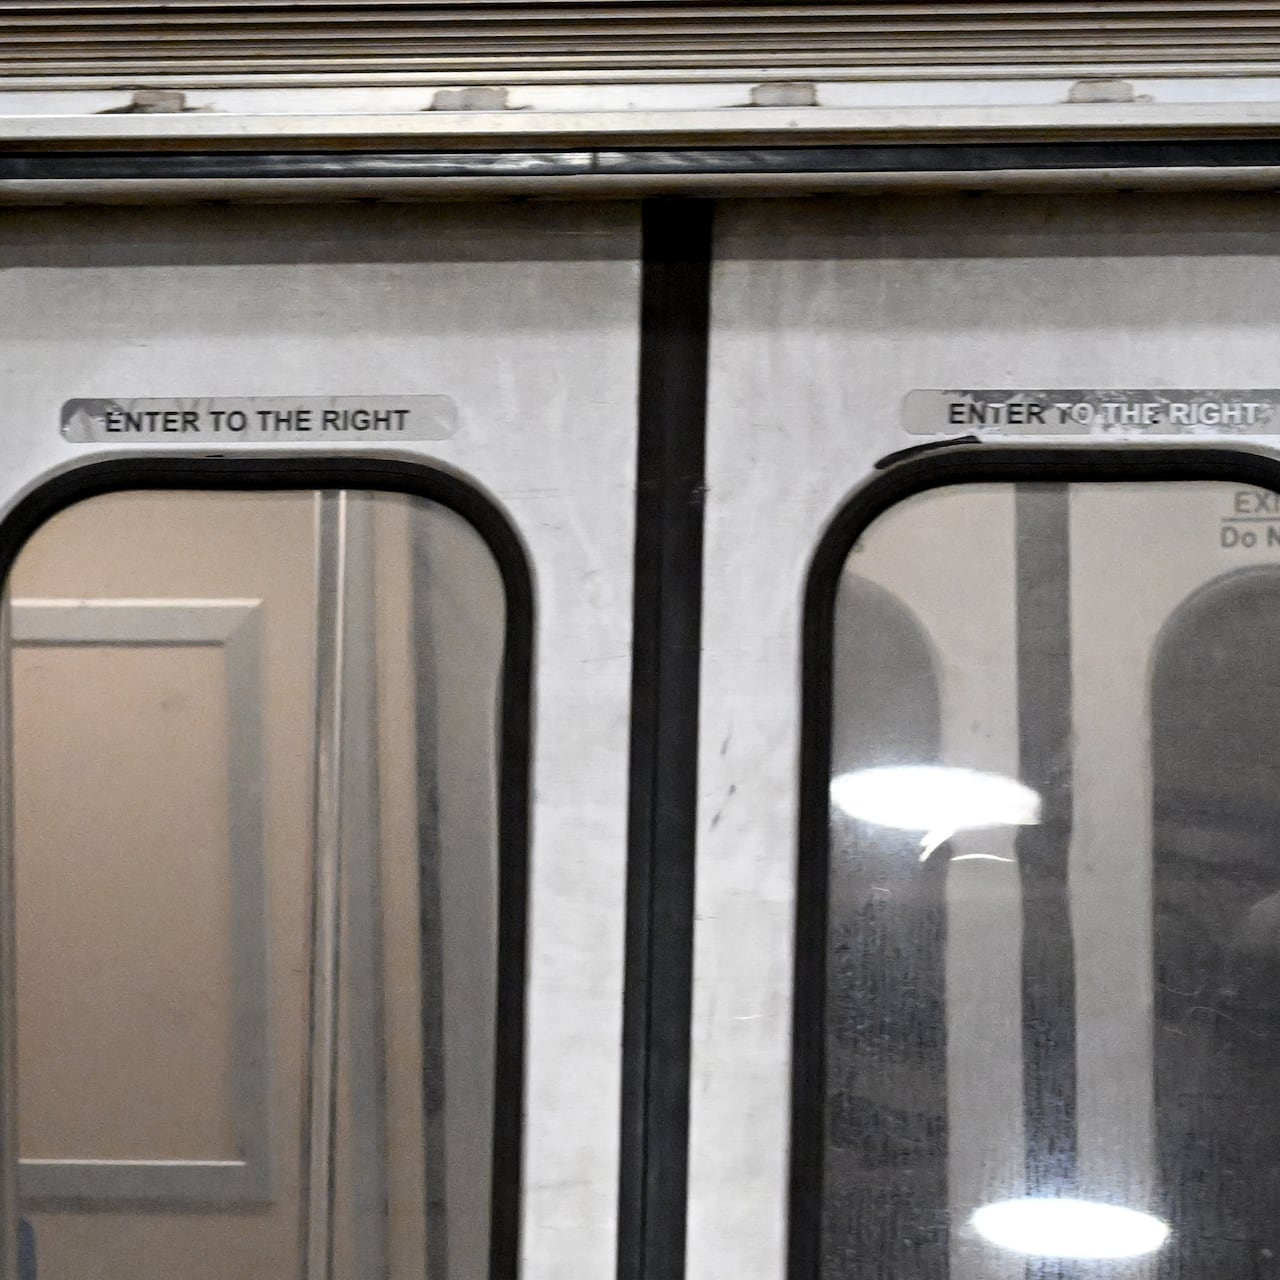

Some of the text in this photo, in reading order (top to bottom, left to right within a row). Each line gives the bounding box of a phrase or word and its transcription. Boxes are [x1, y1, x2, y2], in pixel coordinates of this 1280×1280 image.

[105, 408, 411, 433] ENTER TO THE RIGHT
[948, 402, 1260, 425] ENTER TO THE RIGHT
[1221, 526, 1257, 548] Do
